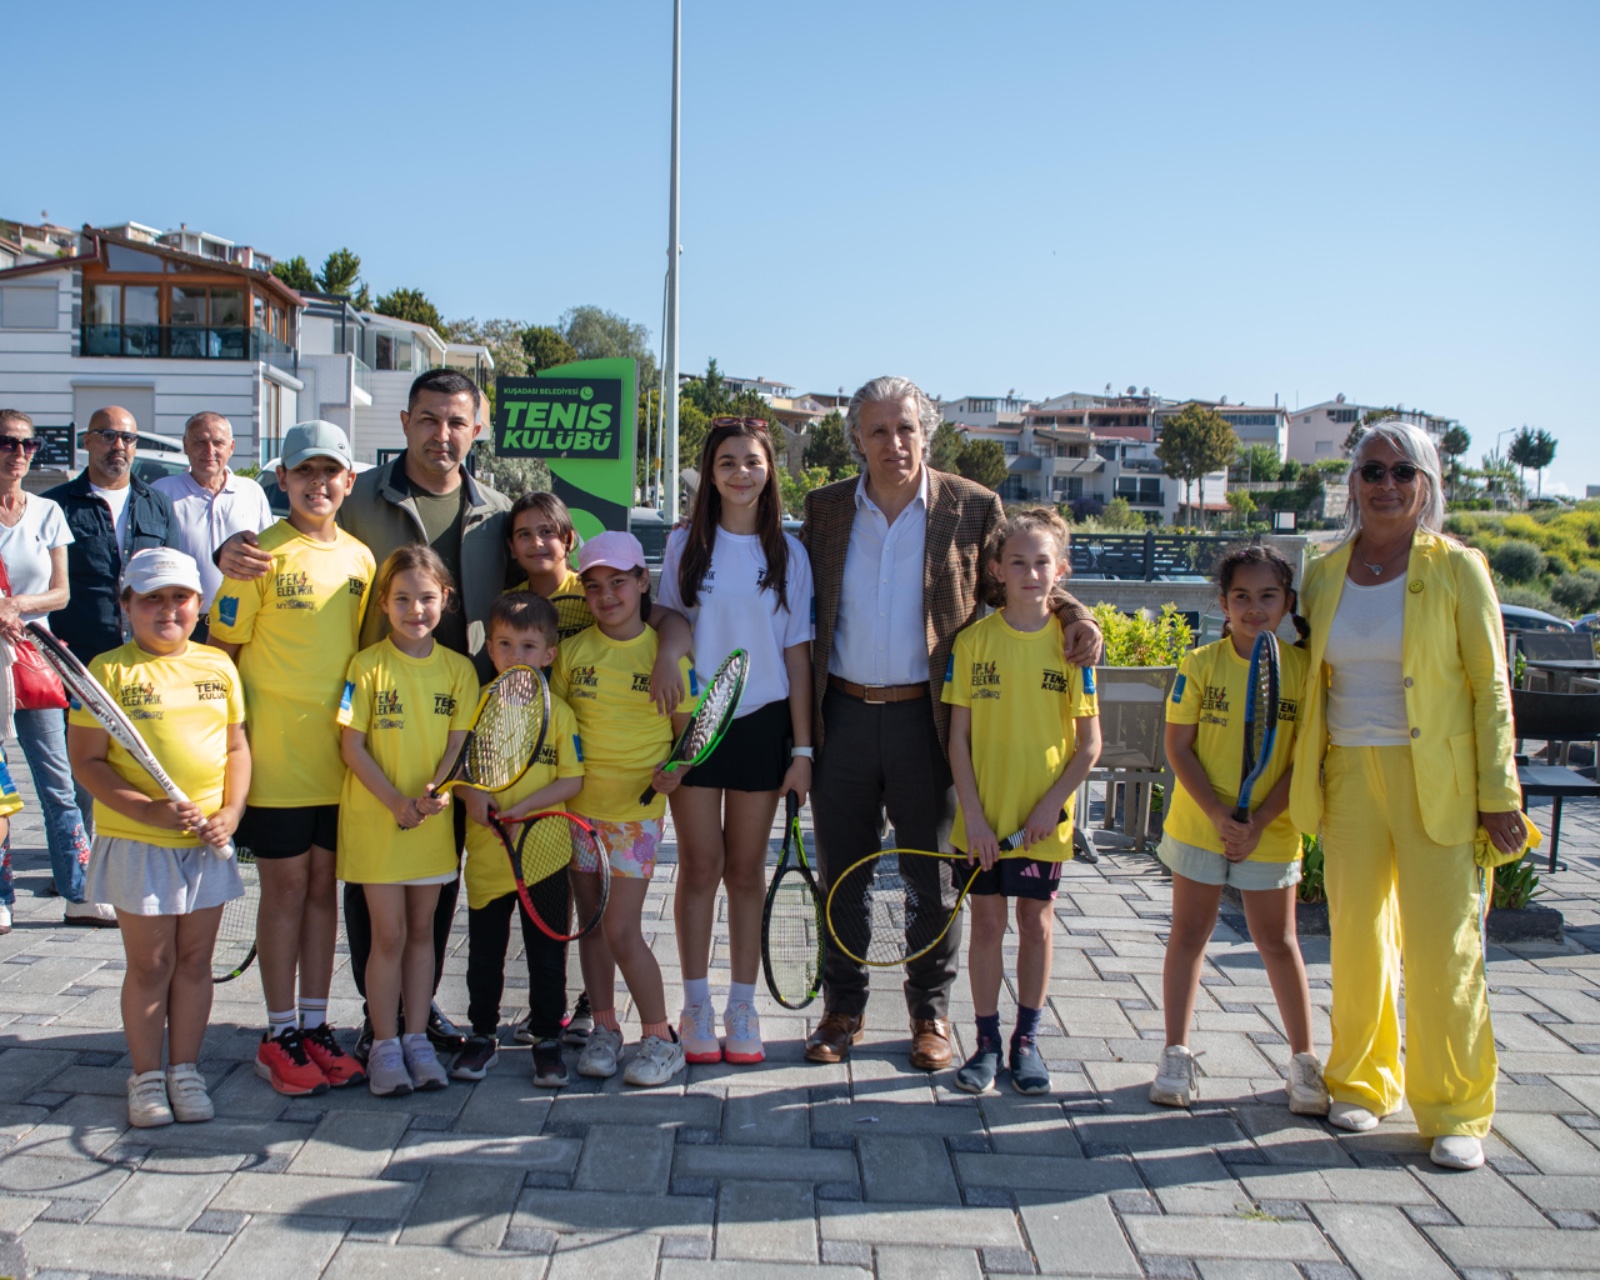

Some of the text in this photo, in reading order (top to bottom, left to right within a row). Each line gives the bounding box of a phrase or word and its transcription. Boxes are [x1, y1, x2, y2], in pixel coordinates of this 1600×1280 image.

[504, 387, 579, 396] KUŞADASI BELEDİYESİ
[502, 430, 612, 451] KULÜBÜ
